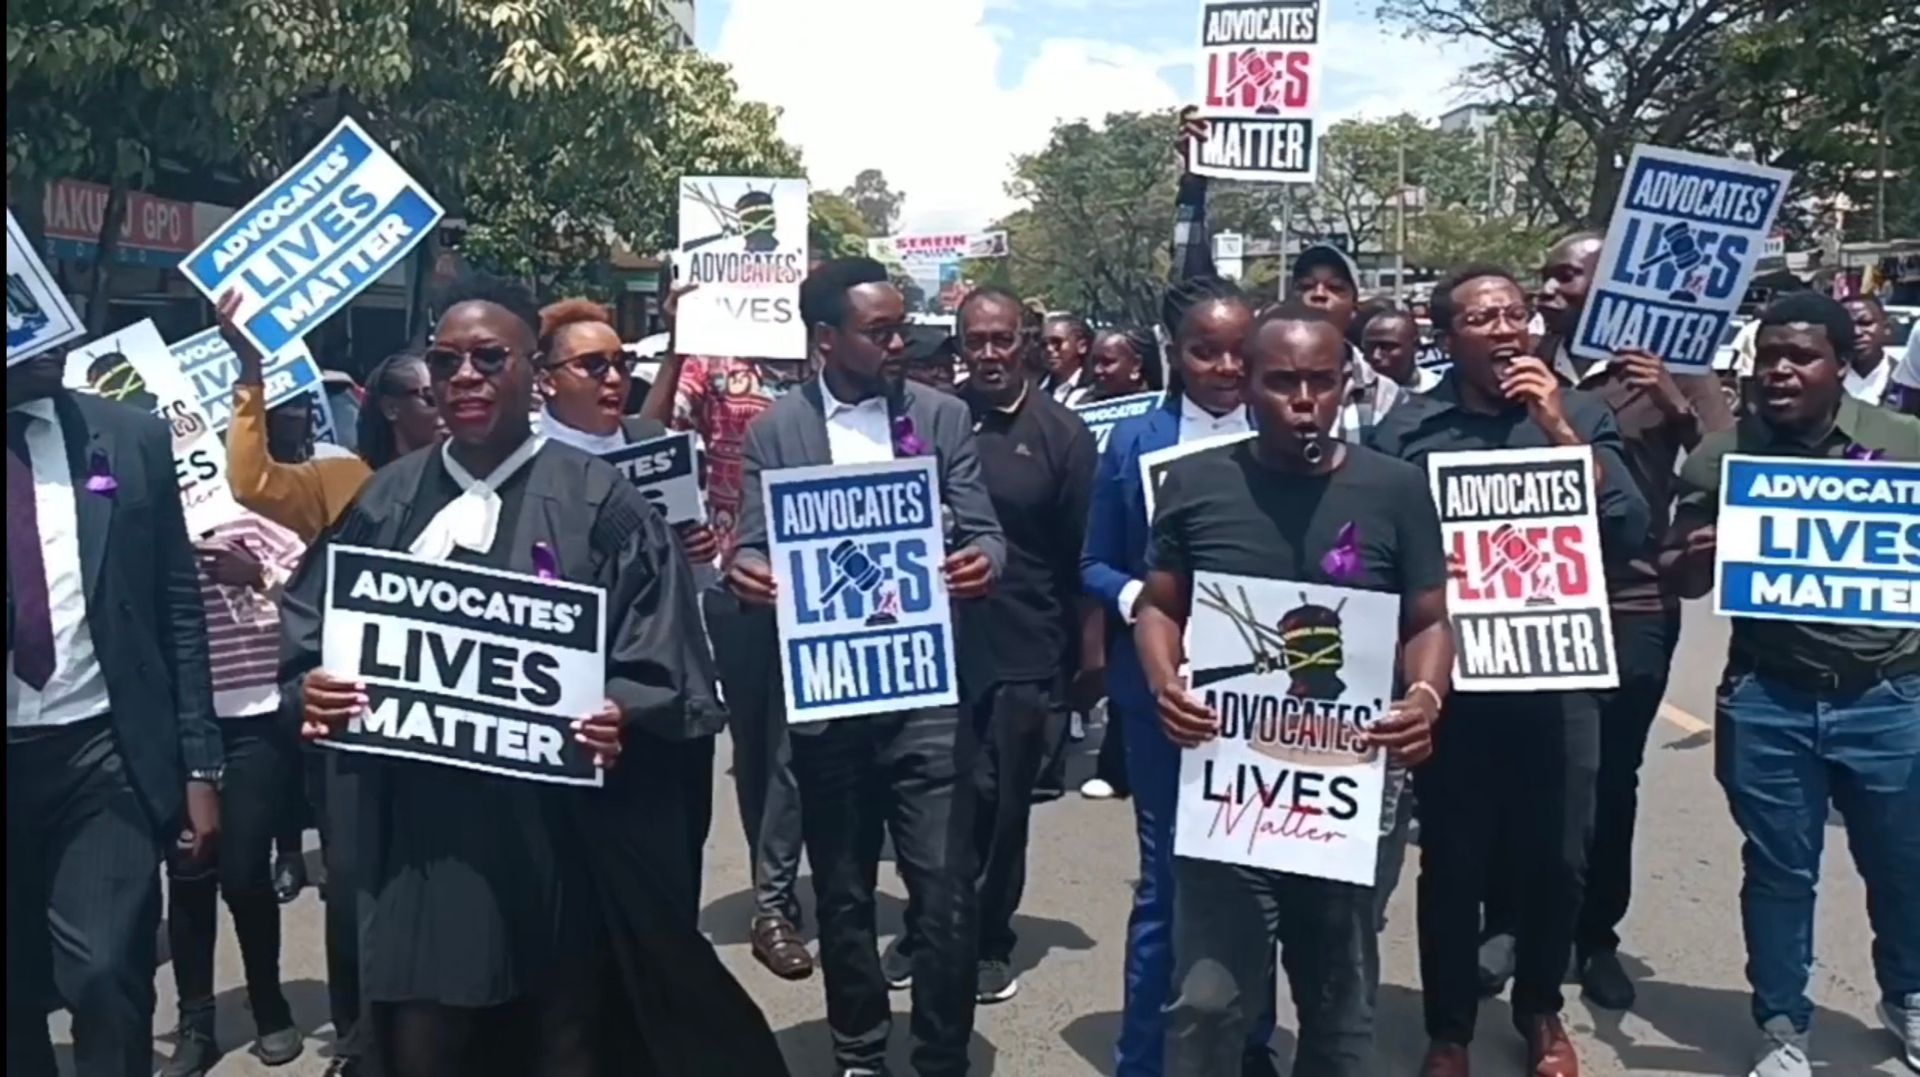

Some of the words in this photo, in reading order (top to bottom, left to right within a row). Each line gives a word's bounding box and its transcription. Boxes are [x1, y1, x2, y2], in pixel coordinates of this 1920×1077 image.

[1206, 2, 1319, 43] ADVOCATES'
[1201, 120, 1304, 169] MATTER
[142, 201, 182, 243] GPO
[212, 143, 349, 273] ADVOCATES'
[1633, 168, 1778, 225] ADVOCATES'
[241, 184, 378, 299] LIVES
[270, 212, 413, 332] MATTER
[689, 247, 803, 284] ADVOCATES'
[1592, 296, 1719, 359] MATTER
[783, 473, 929, 537] ADVOCATES'
[1445, 470, 1582, 517] ADVOCATES
[350, 570, 583, 634] ADVOCATES'
[359, 622, 562, 707] LIVES
[798, 631, 939, 703] MATTER
[1460, 615, 1600, 675] MATTER
[348, 697, 565, 767] MATTER
[1204, 690, 1383, 754] ADVOCATES'
[1202, 760, 1359, 821] LIVES
[1207, 783, 1348, 856] Matter
